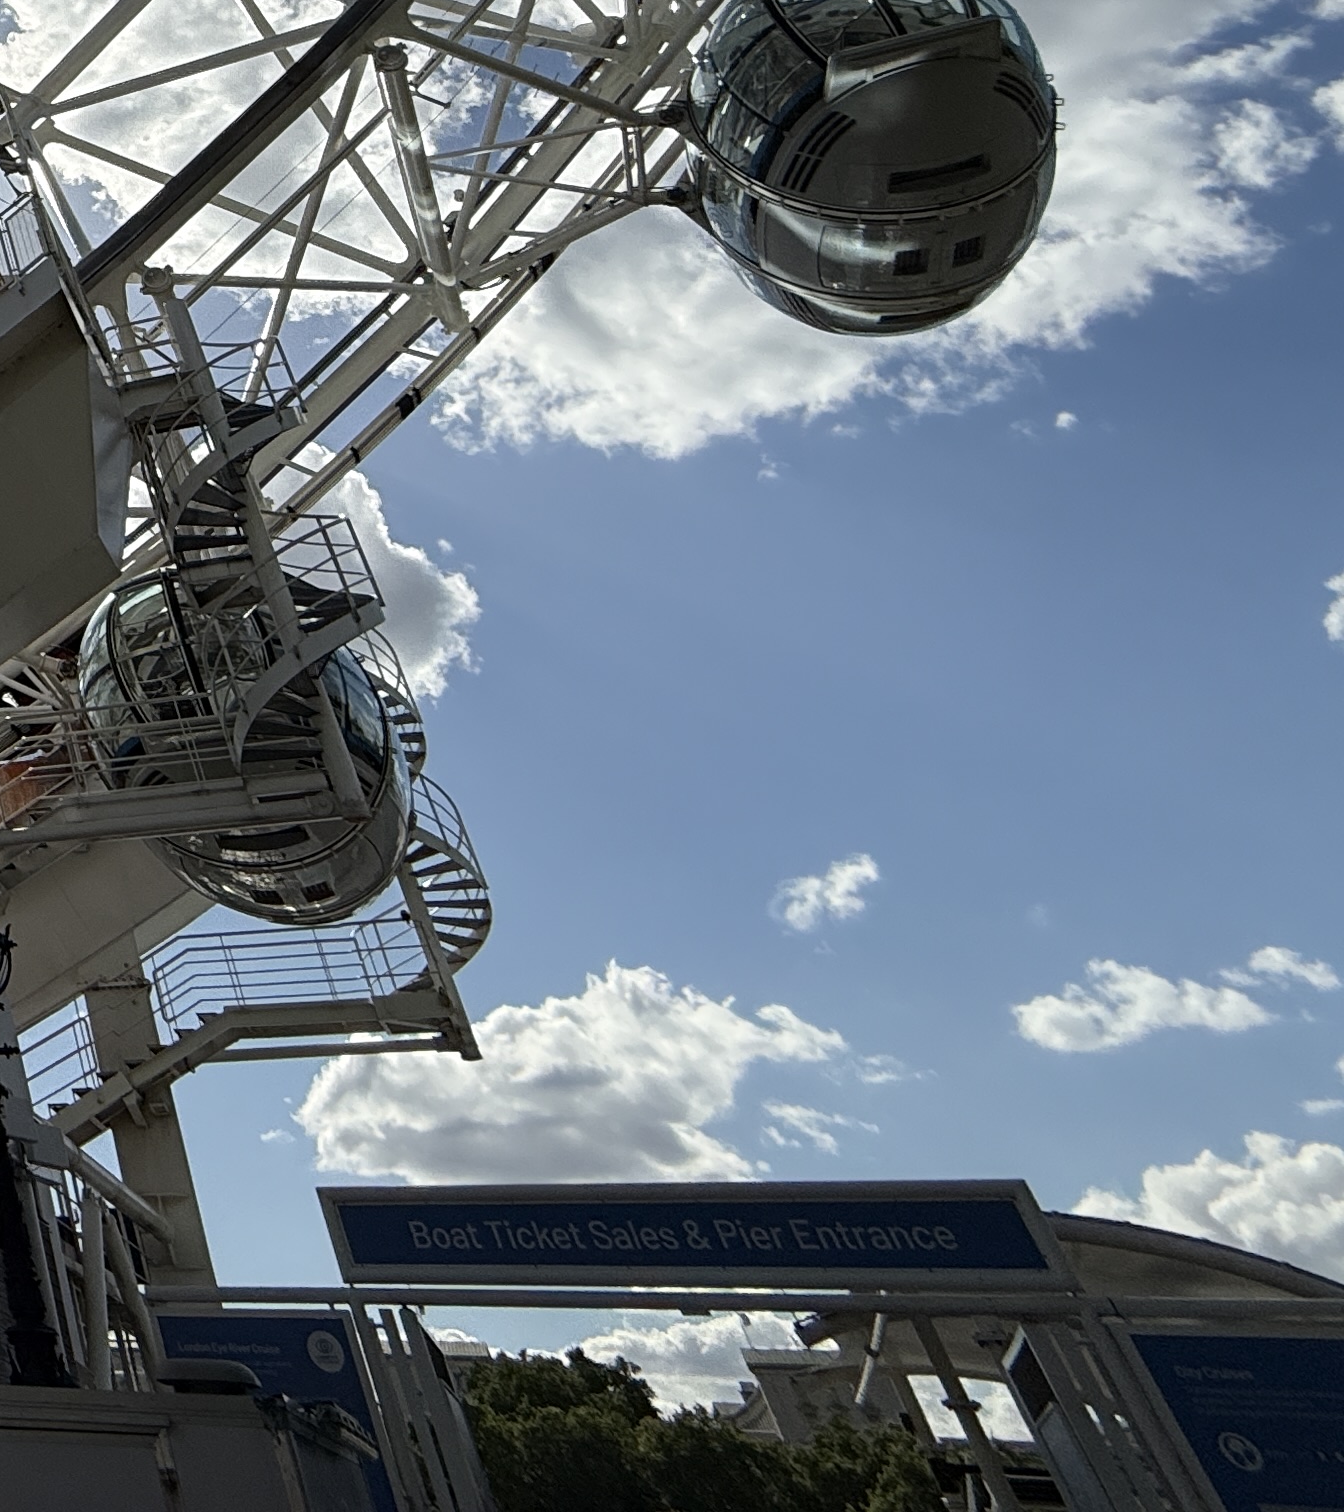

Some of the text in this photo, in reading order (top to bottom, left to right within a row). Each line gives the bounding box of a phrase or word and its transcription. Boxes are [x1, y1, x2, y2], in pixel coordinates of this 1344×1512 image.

[407, 1219, 959, 1251] Boat Ticket Sales & Pier Entrance
